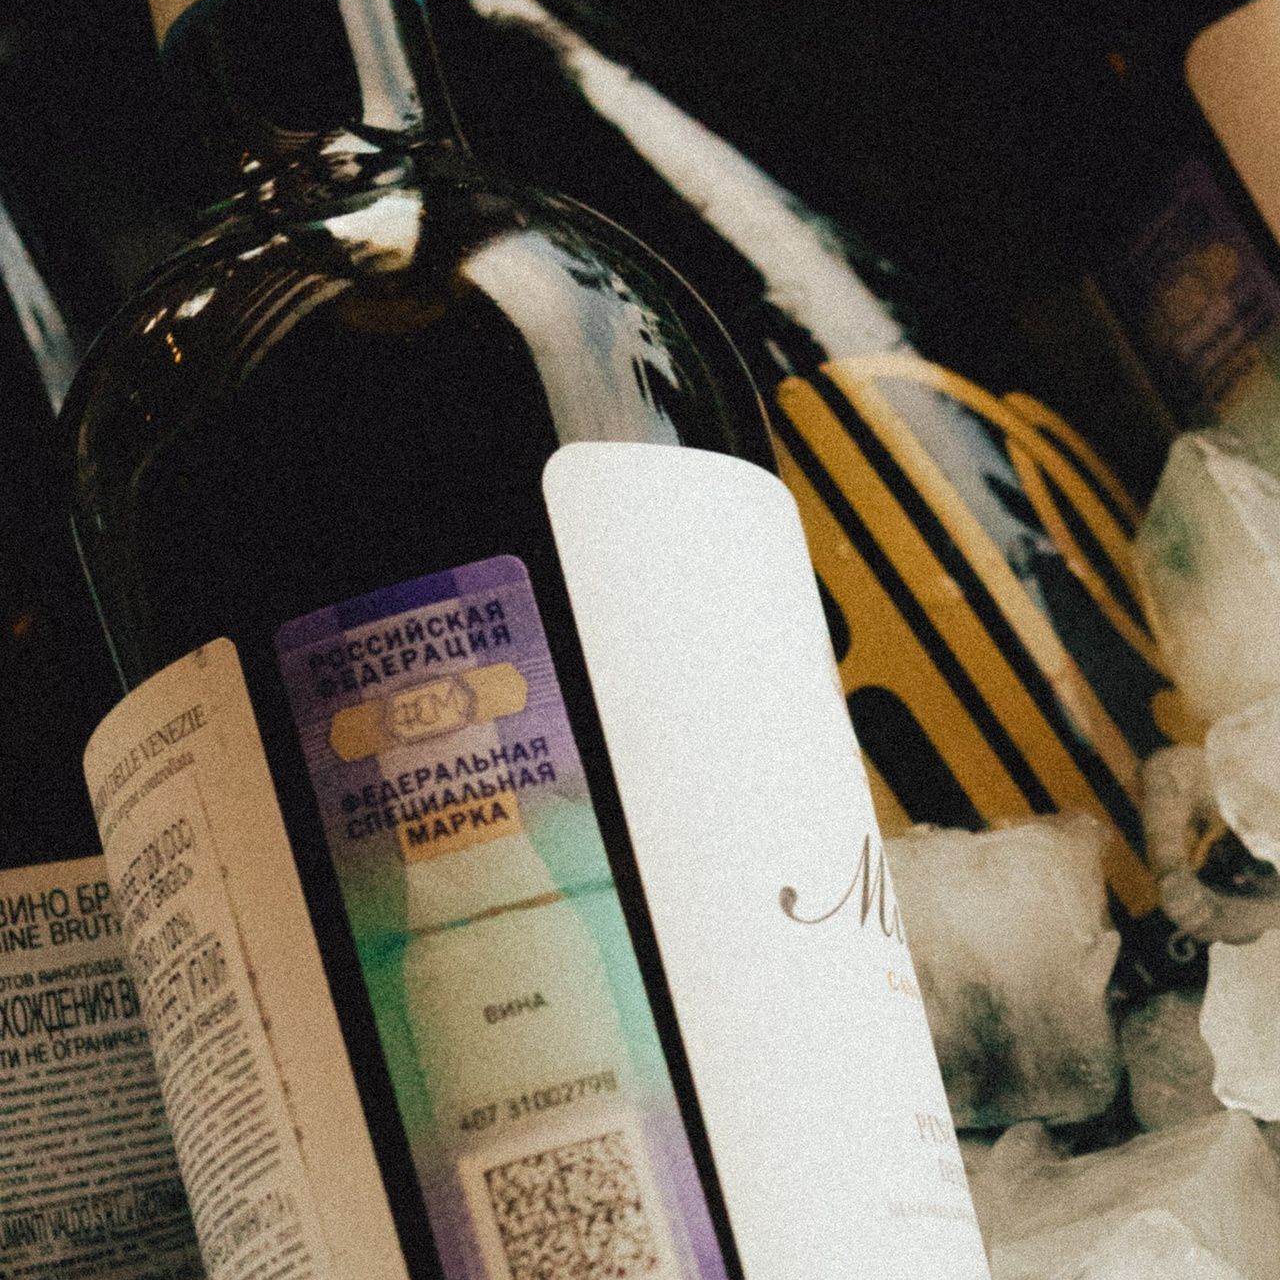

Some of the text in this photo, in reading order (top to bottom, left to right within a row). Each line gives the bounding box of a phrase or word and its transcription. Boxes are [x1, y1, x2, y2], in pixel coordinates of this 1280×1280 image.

[307, 599, 507, 672] РОССИЙСКАЯ
[316, 626, 513, 698] ФЕДЕРАЦИЯ
[340, 736, 551, 815] ФЕДЕРАЛЬНАЯ
[345, 761, 558, 841] СПЕЦИАЛЬНАЯ
[405, 801, 510, 847] МАРКА
